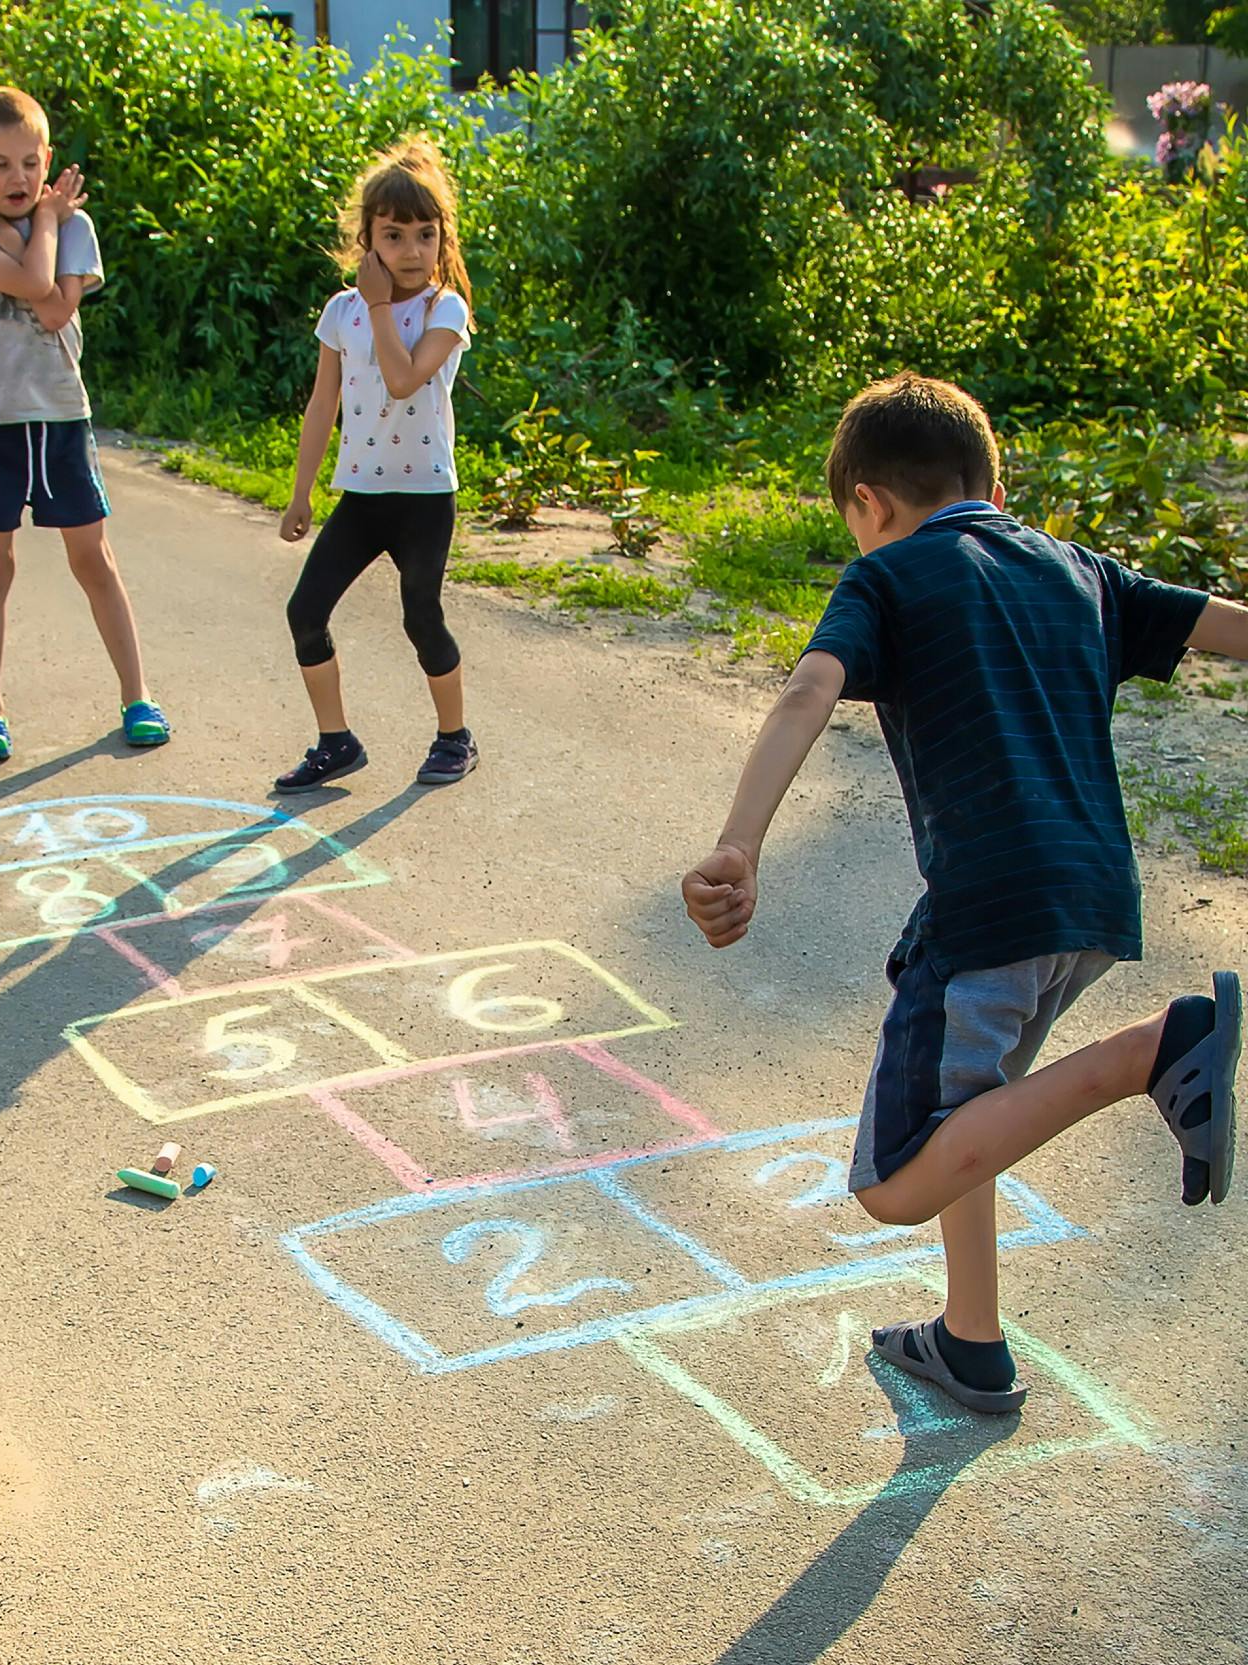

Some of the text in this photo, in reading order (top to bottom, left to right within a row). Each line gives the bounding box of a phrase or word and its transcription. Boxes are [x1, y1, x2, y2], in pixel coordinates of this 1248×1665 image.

[14, 807, 148, 853] 10
[16, 843, 289, 924] 8 9
[190, 914, 318, 969] 7
[203, 962, 564, 1080] 5 6
[455, 1072, 572, 1149] 4
[442, 1218, 634, 1317] 2
